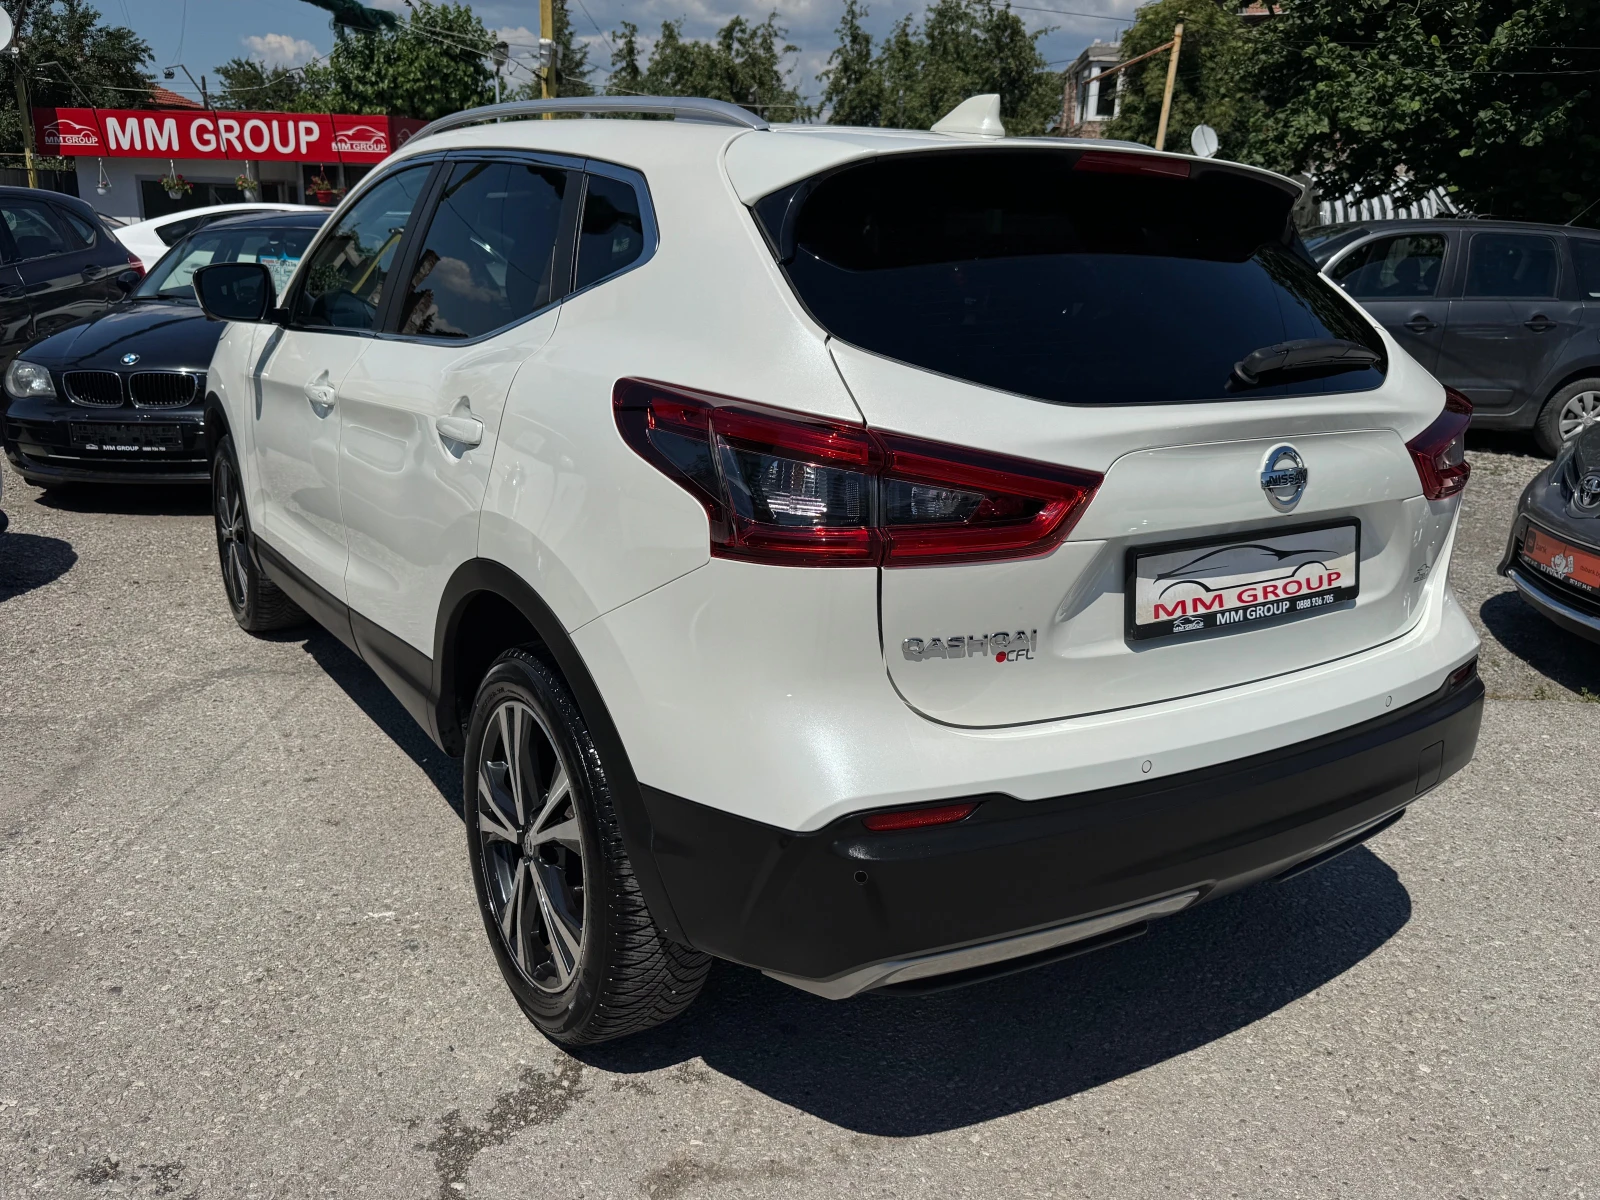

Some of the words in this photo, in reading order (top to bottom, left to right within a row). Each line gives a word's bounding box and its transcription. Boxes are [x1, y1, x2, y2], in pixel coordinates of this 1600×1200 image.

[45, 136, 63, 144] MM
[65, 136, 98, 145] GROUP
[106, 117, 180, 152] MM
[190, 118, 320, 154] GROUP
[331, 142, 351, 151] MM
[353, 143, 387, 152] GROUP
[1268, 469, 1307, 487] NISSAN
[1153, 594, 1224, 619] MM
[1237, 571, 1342, 604] GROUP
[1216, 608, 1244, 626] MM
[1246, 601, 1290, 620] GROUP
[1296, 599, 1310, 610] 0888
[1310, 597, 1323, 608] 936
[1323, 594, 1334, 605] 705
[902, 629, 1037, 658] QASHQAI
[1006, 648, 1034, 662] CFL
